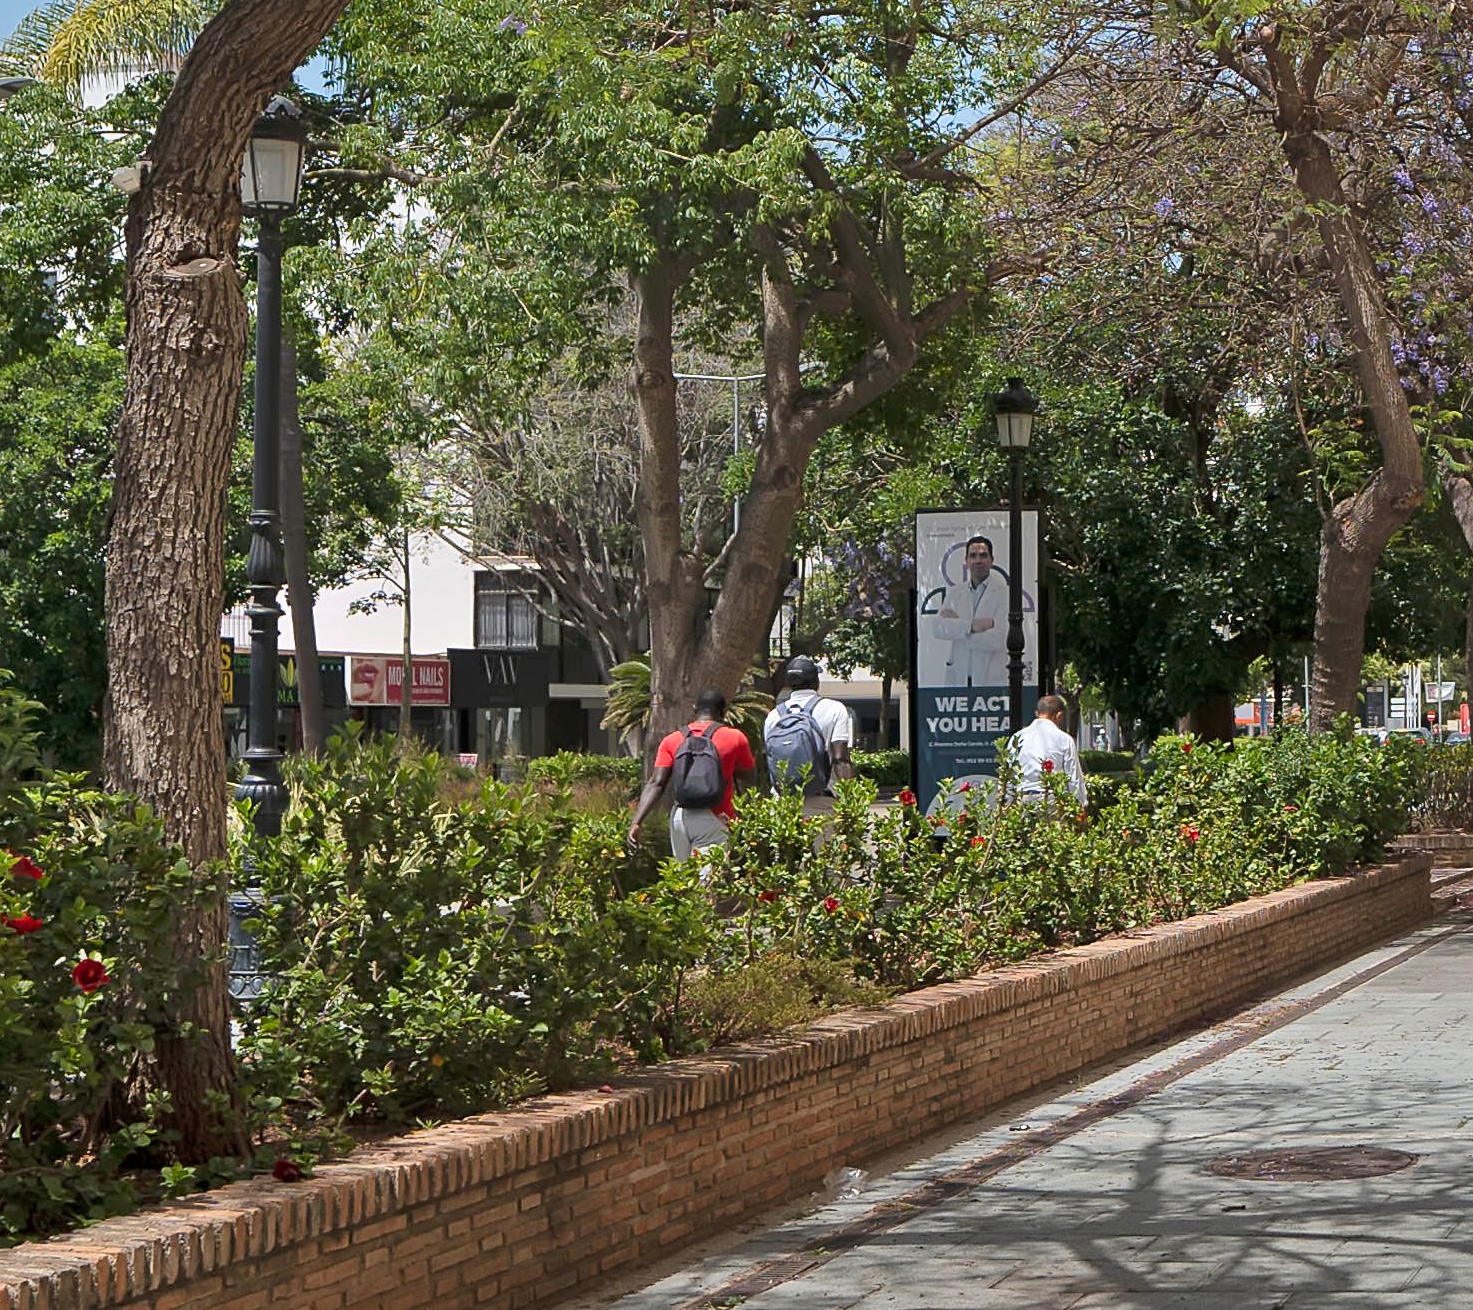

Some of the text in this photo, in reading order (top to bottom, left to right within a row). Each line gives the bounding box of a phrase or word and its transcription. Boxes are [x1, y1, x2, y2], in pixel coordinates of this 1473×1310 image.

[419, 666, 445, 687] NAILS
[934, 696, 969, 713] WE
[926, 717, 1011, 733] YOU HEA
